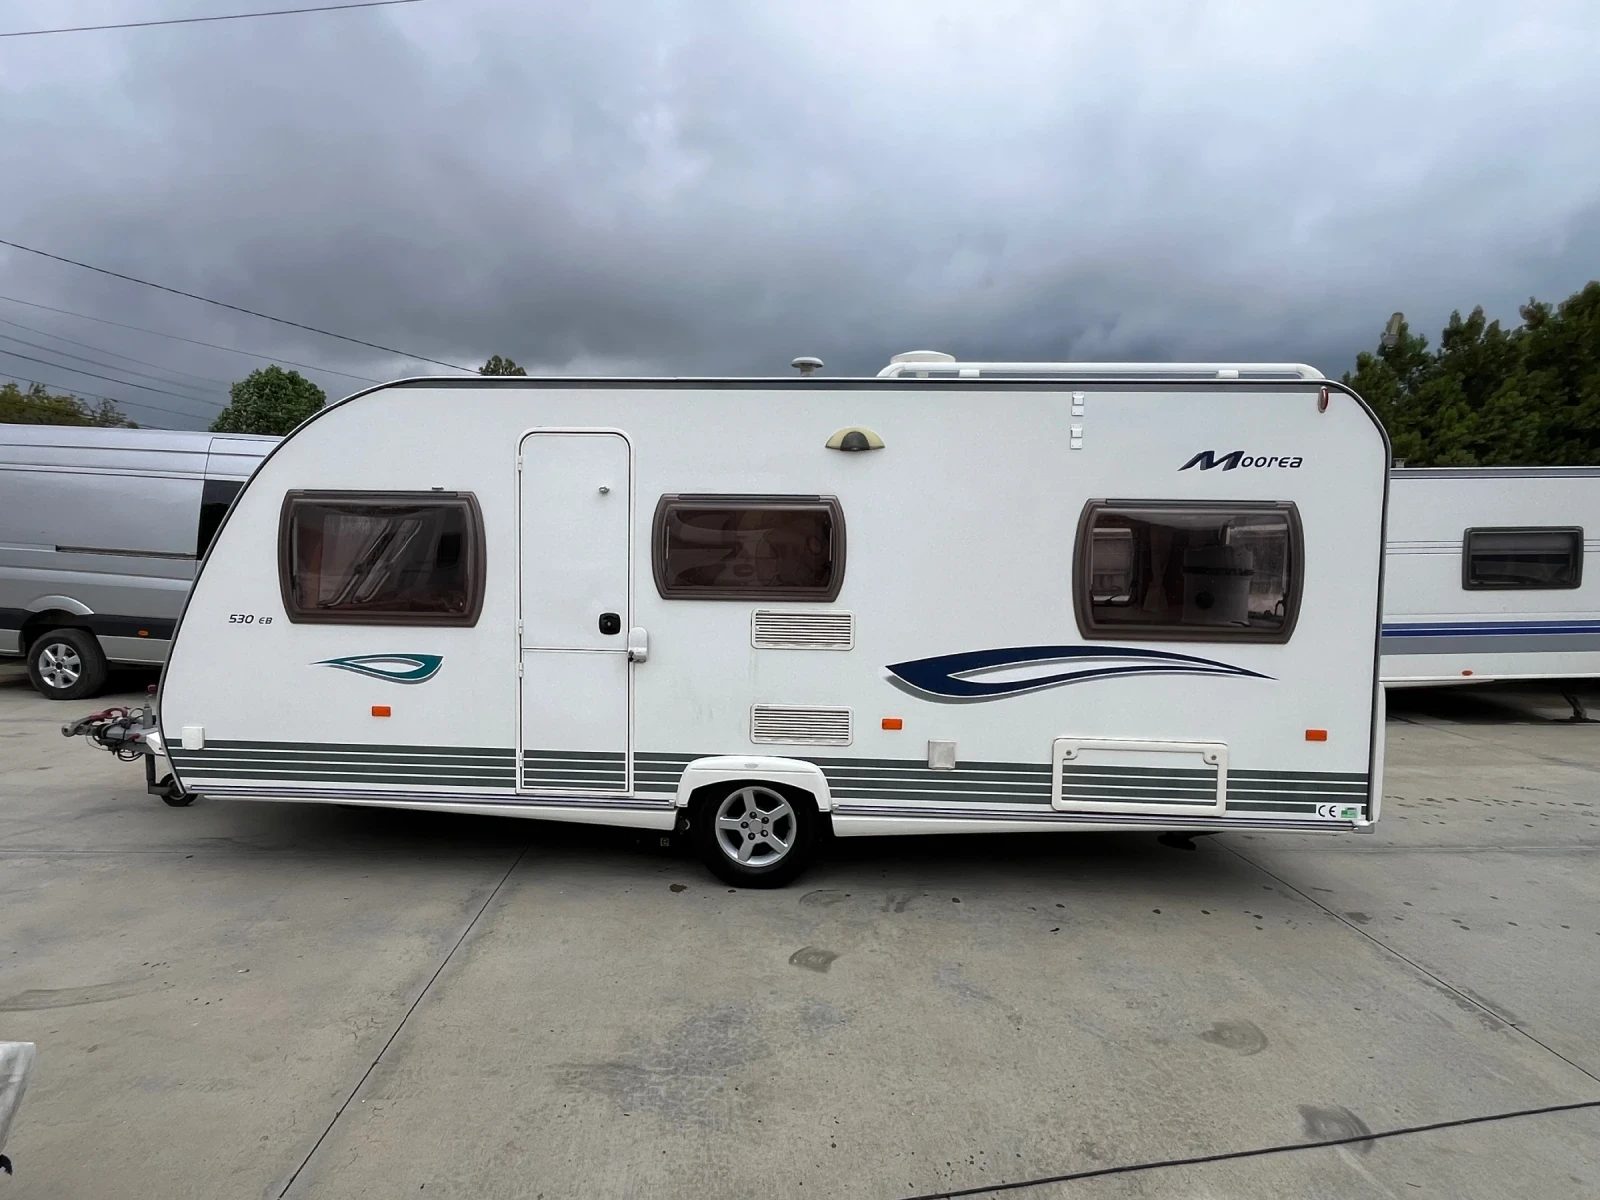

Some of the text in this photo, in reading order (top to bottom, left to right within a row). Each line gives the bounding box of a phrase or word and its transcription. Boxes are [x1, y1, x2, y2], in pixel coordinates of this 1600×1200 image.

[1177, 450, 1304, 472] Moorea
[228, 614, 273, 625] 530 EB
[1318, 804, 1337, 818] CE
